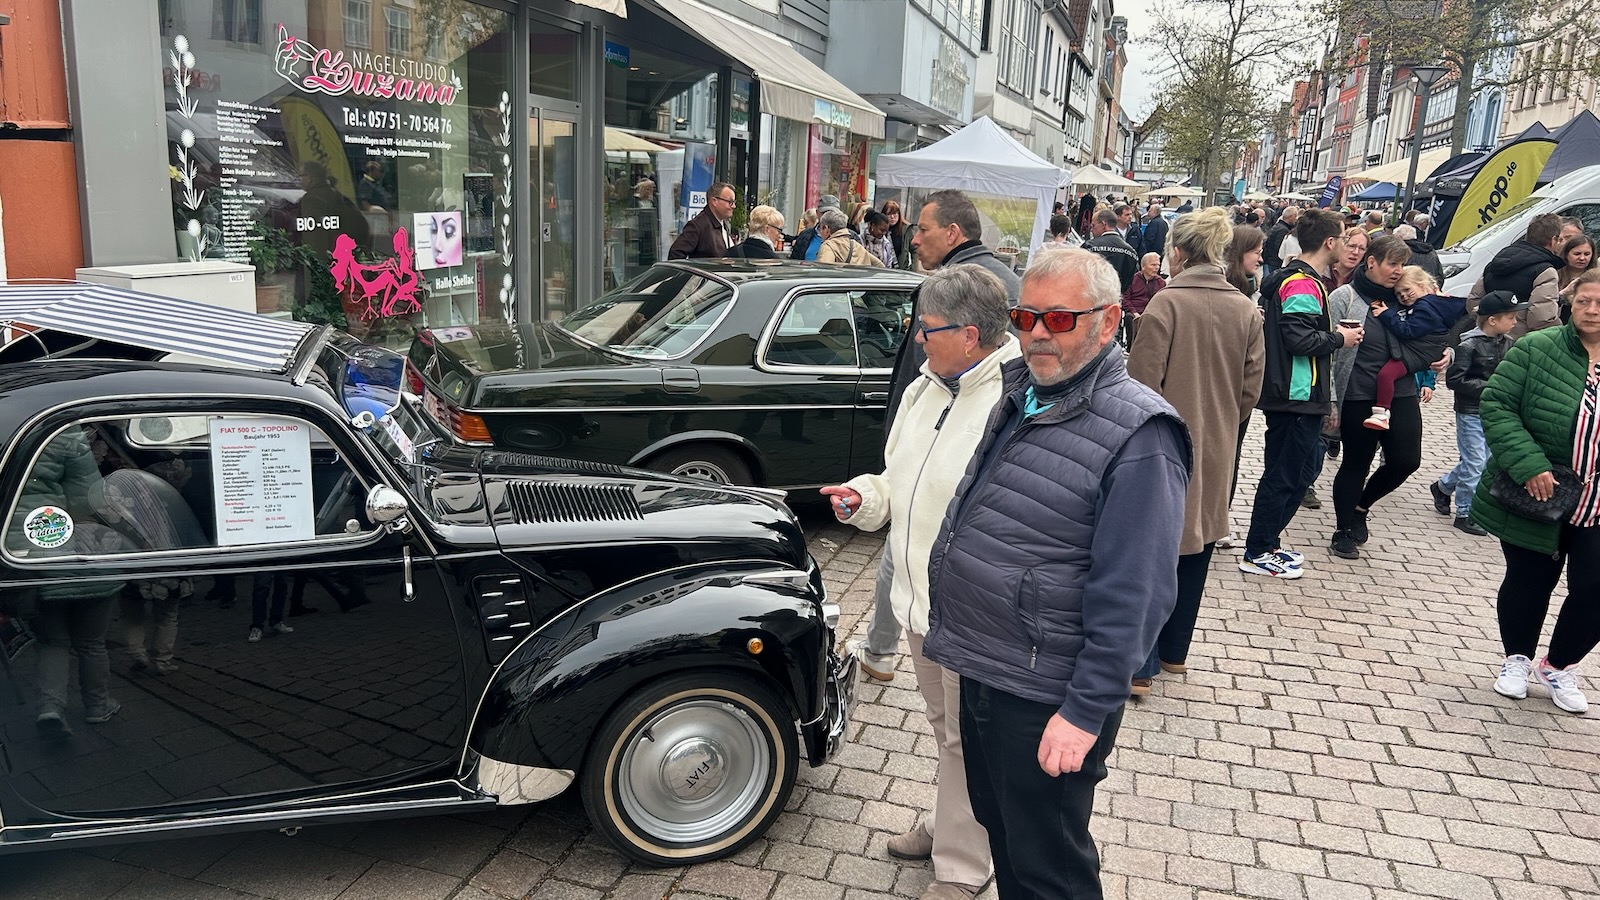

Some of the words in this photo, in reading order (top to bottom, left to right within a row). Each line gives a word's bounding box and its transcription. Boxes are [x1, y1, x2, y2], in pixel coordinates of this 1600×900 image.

[353, 51, 447, 82] NAGELSTUDIO
[342, 107, 367, 127] Tel.:
[368, 110, 388, 129] 057
[389, 113, 401, 130] 51
[409, 114, 421, 132] 70
[422, 115, 440, 133] 564
[441, 118, 452, 134] 76
[344, 135, 379, 146] Neumodellagen
[386, 138, 393, 146] UV
[366, 147, 381, 156] French
[383, 148, 397, 158] Design
[692, 194, 706, 204] Bio
[296, 217, 315, 231] BIO
[435, 277, 453, 290] Hallo
[453, 274, 474, 288] Shellac
[29, 524, 70, 539] Oldtimer
[685, 761, 710, 789] FIAT
